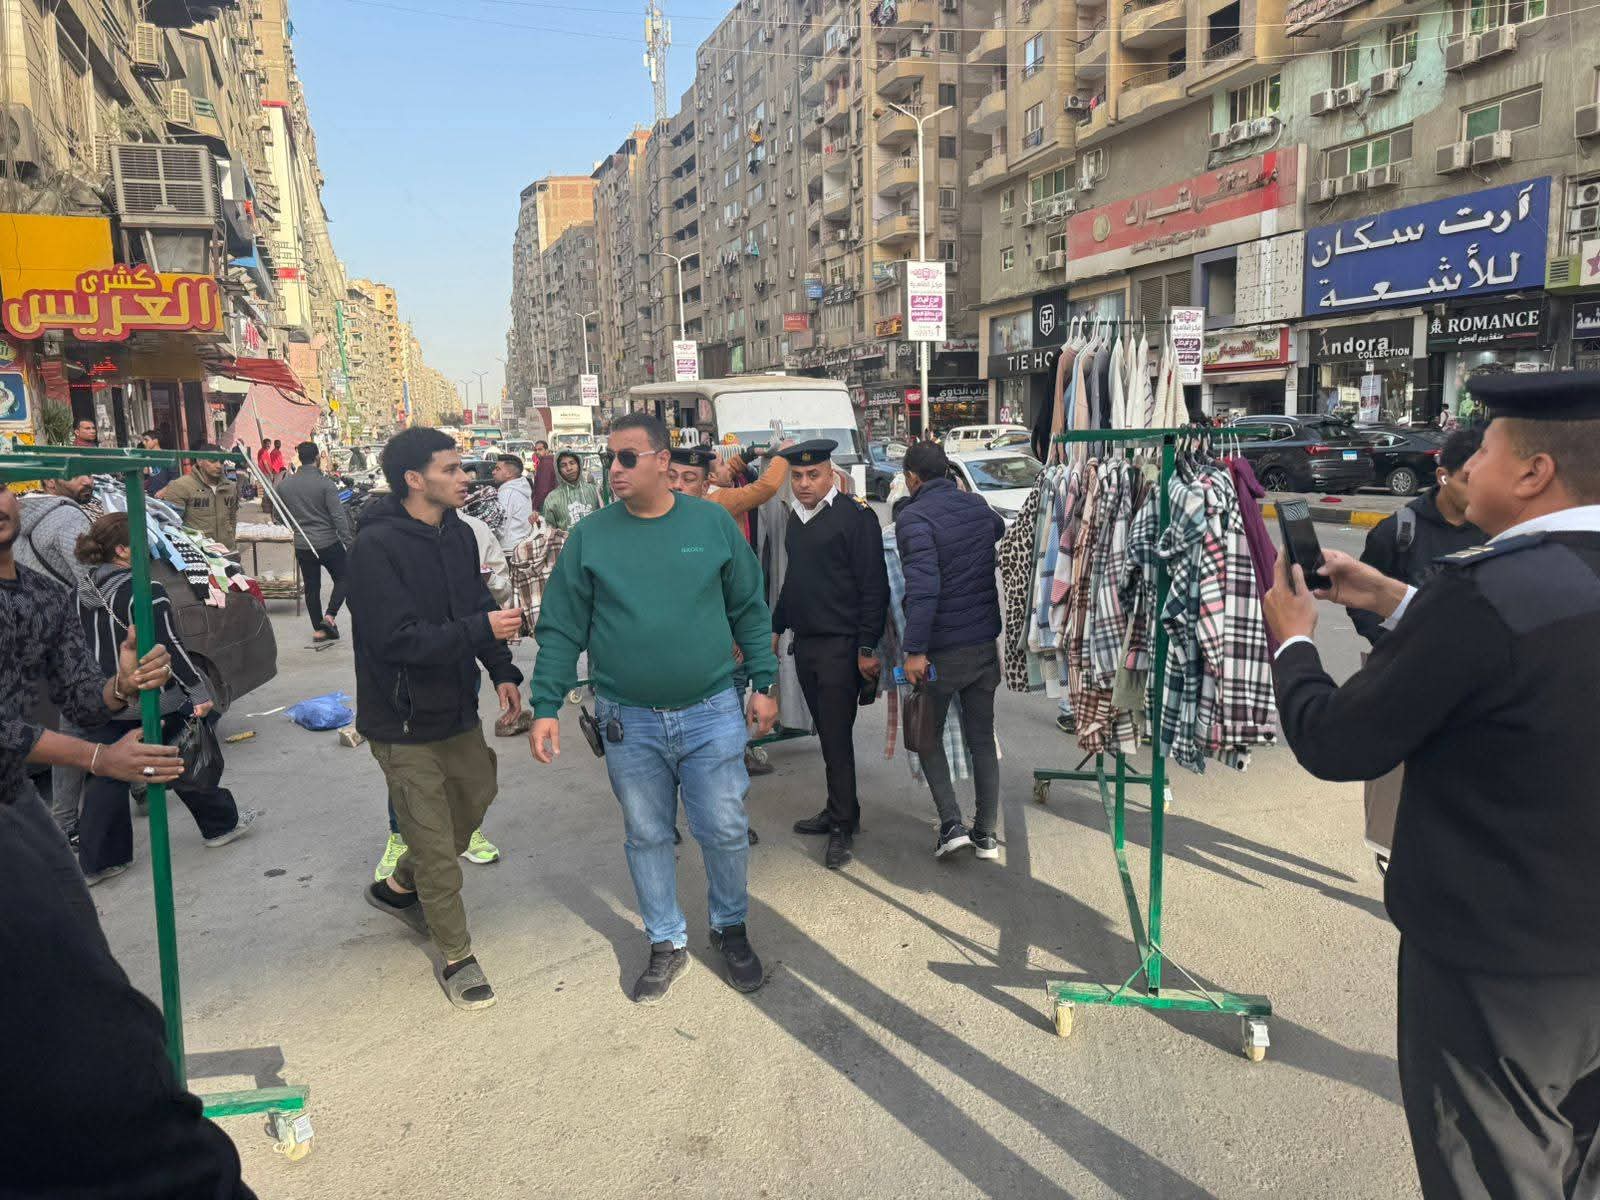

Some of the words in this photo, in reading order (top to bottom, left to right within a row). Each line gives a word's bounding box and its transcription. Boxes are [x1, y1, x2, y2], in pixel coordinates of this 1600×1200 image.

[1439, 184, 1534, 235] آرت
[1312, 221, 1425, 268] سكان
[1319, 243, 1521, 307] للأشعة
[9, 281, 210, 336] العريس
[1448, 310, 1539, 333] ROMANCE
[1317, 328, 1389, 356] Andora
[1358, 347, 1410, 359] COLLECTION
[1007, 354, 1029, 371] TIE
[1034, 351, 1054, 368] HO
